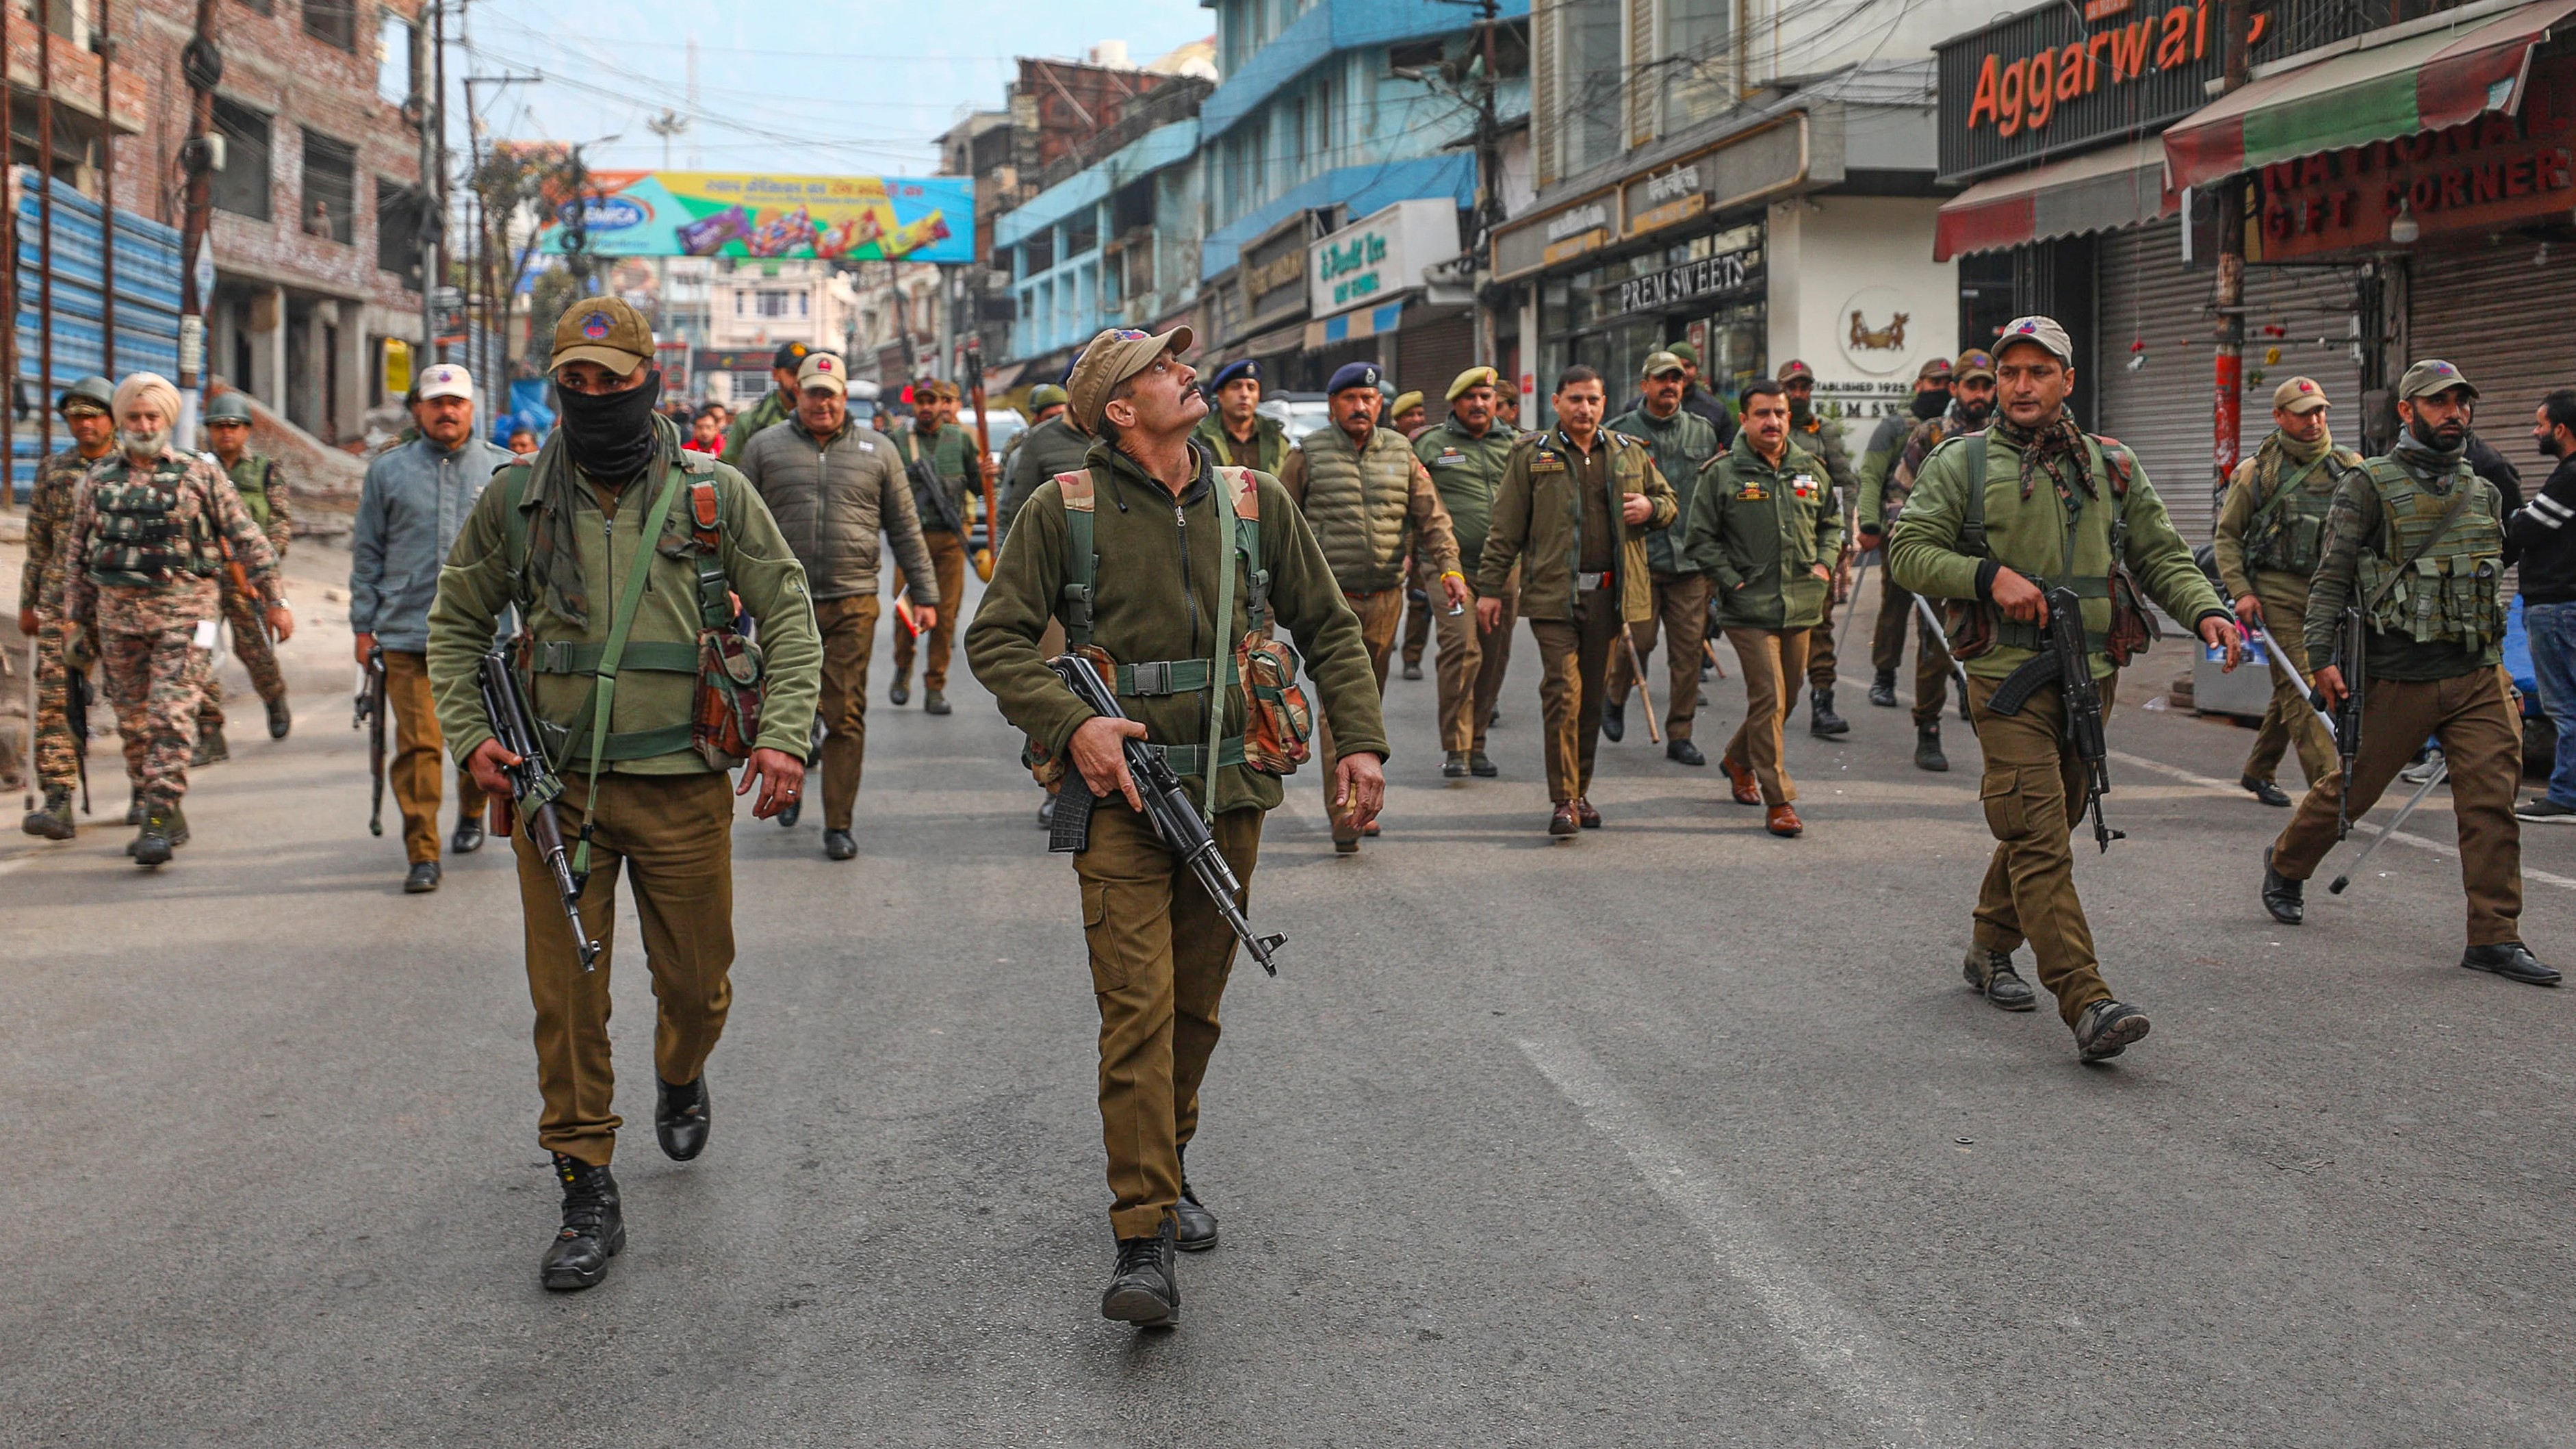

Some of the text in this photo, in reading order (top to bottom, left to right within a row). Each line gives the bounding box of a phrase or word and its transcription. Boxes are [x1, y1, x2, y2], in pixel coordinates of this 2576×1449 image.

[1968, 0, 2265, 137] Aggarwal
[2383, 148, 2568, 216] CORNER
[1621, 251, 1744, 314] PREM SWEETS
